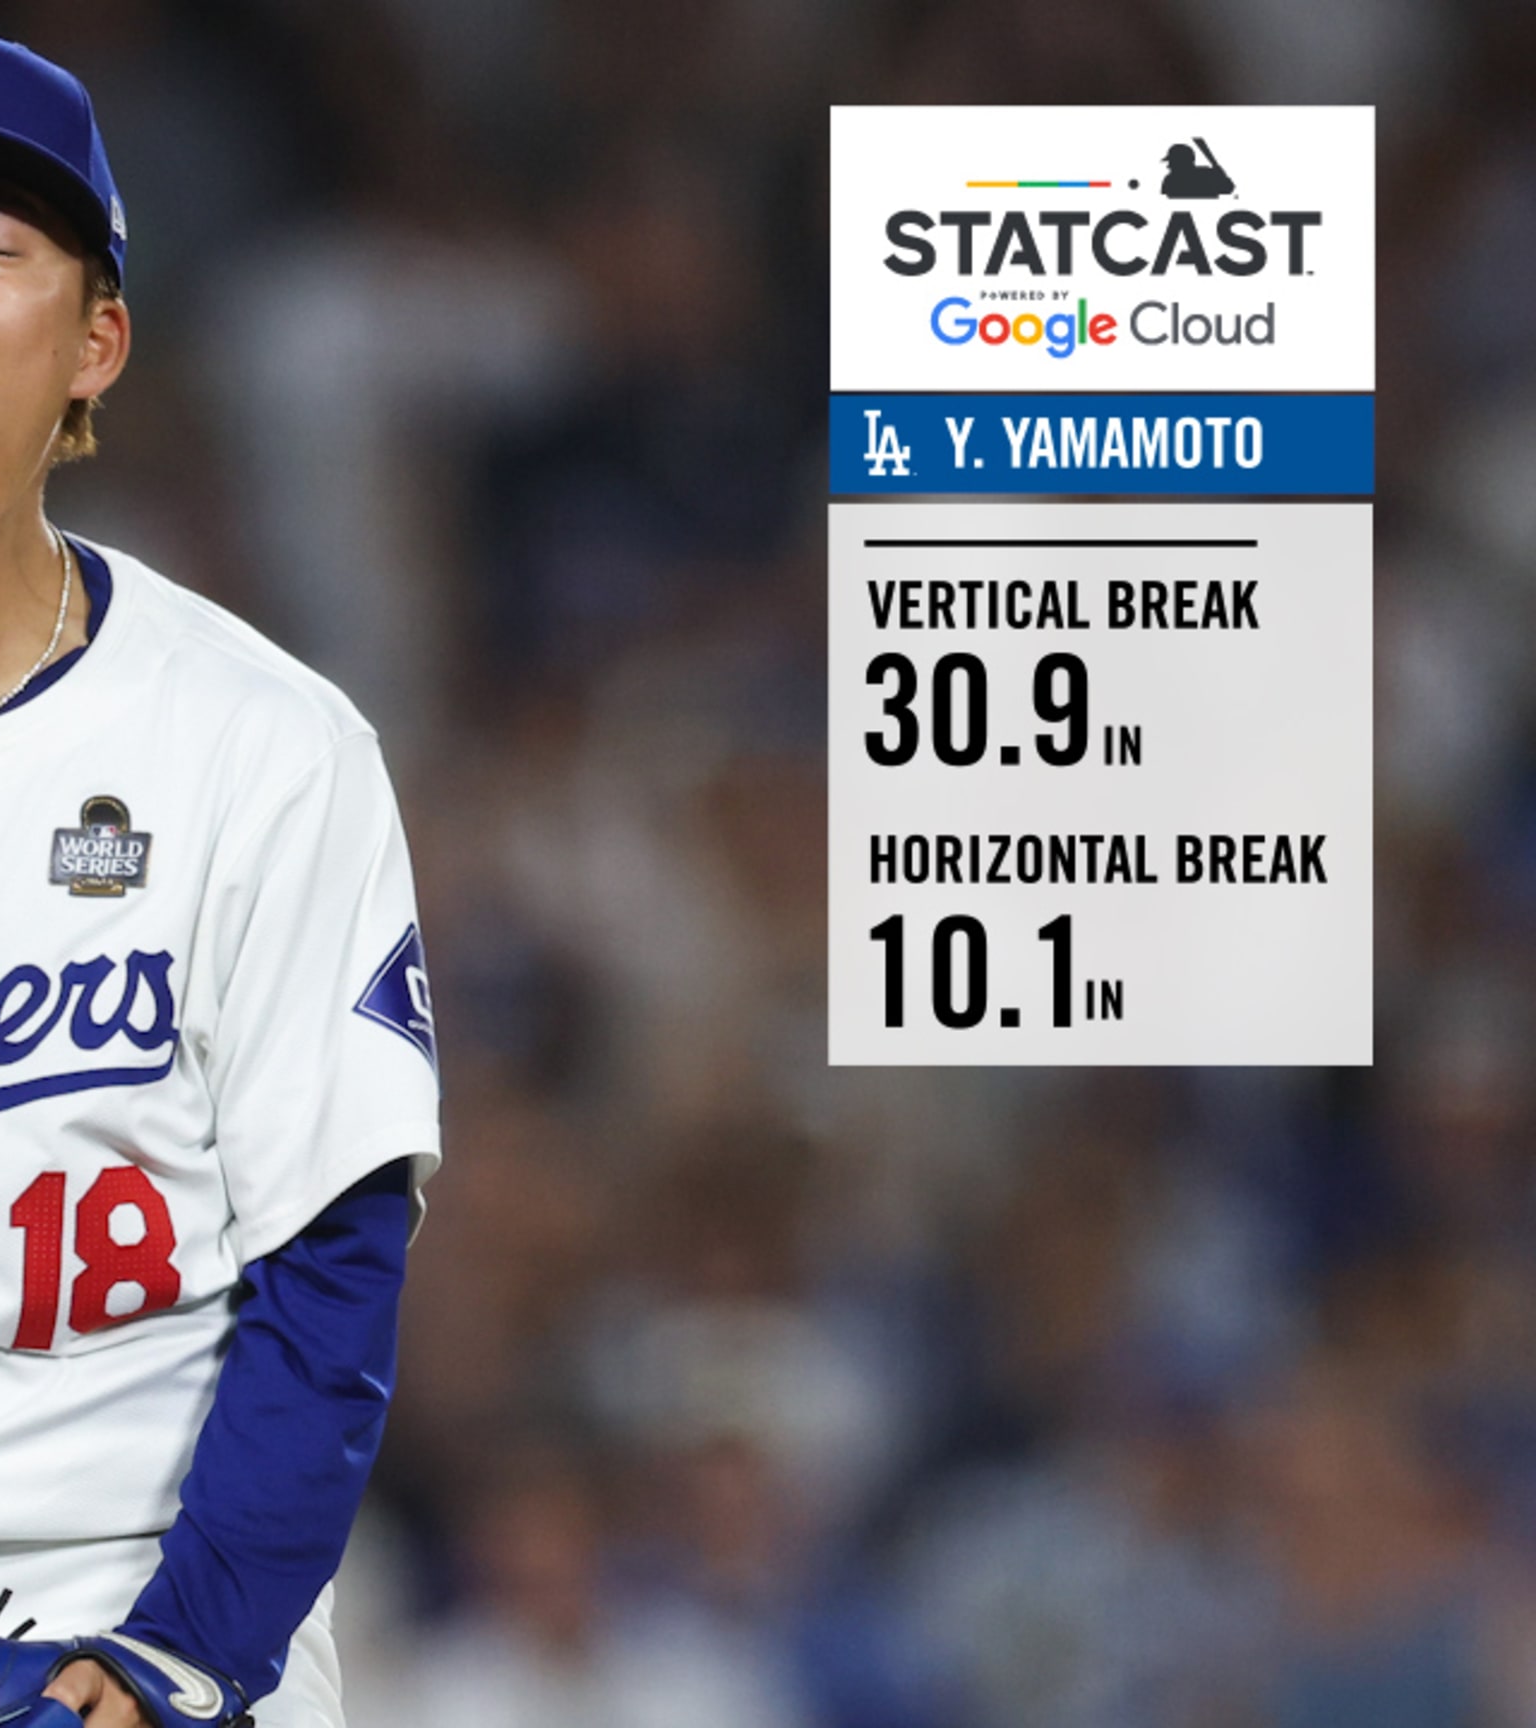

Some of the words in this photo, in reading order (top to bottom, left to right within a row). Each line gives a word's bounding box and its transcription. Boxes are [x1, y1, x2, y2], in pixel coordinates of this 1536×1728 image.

[59, 836, 144, 859] WORLD
[61, 855, 139, 877] SERIES
[10, 1165, 181, 1350] 18
